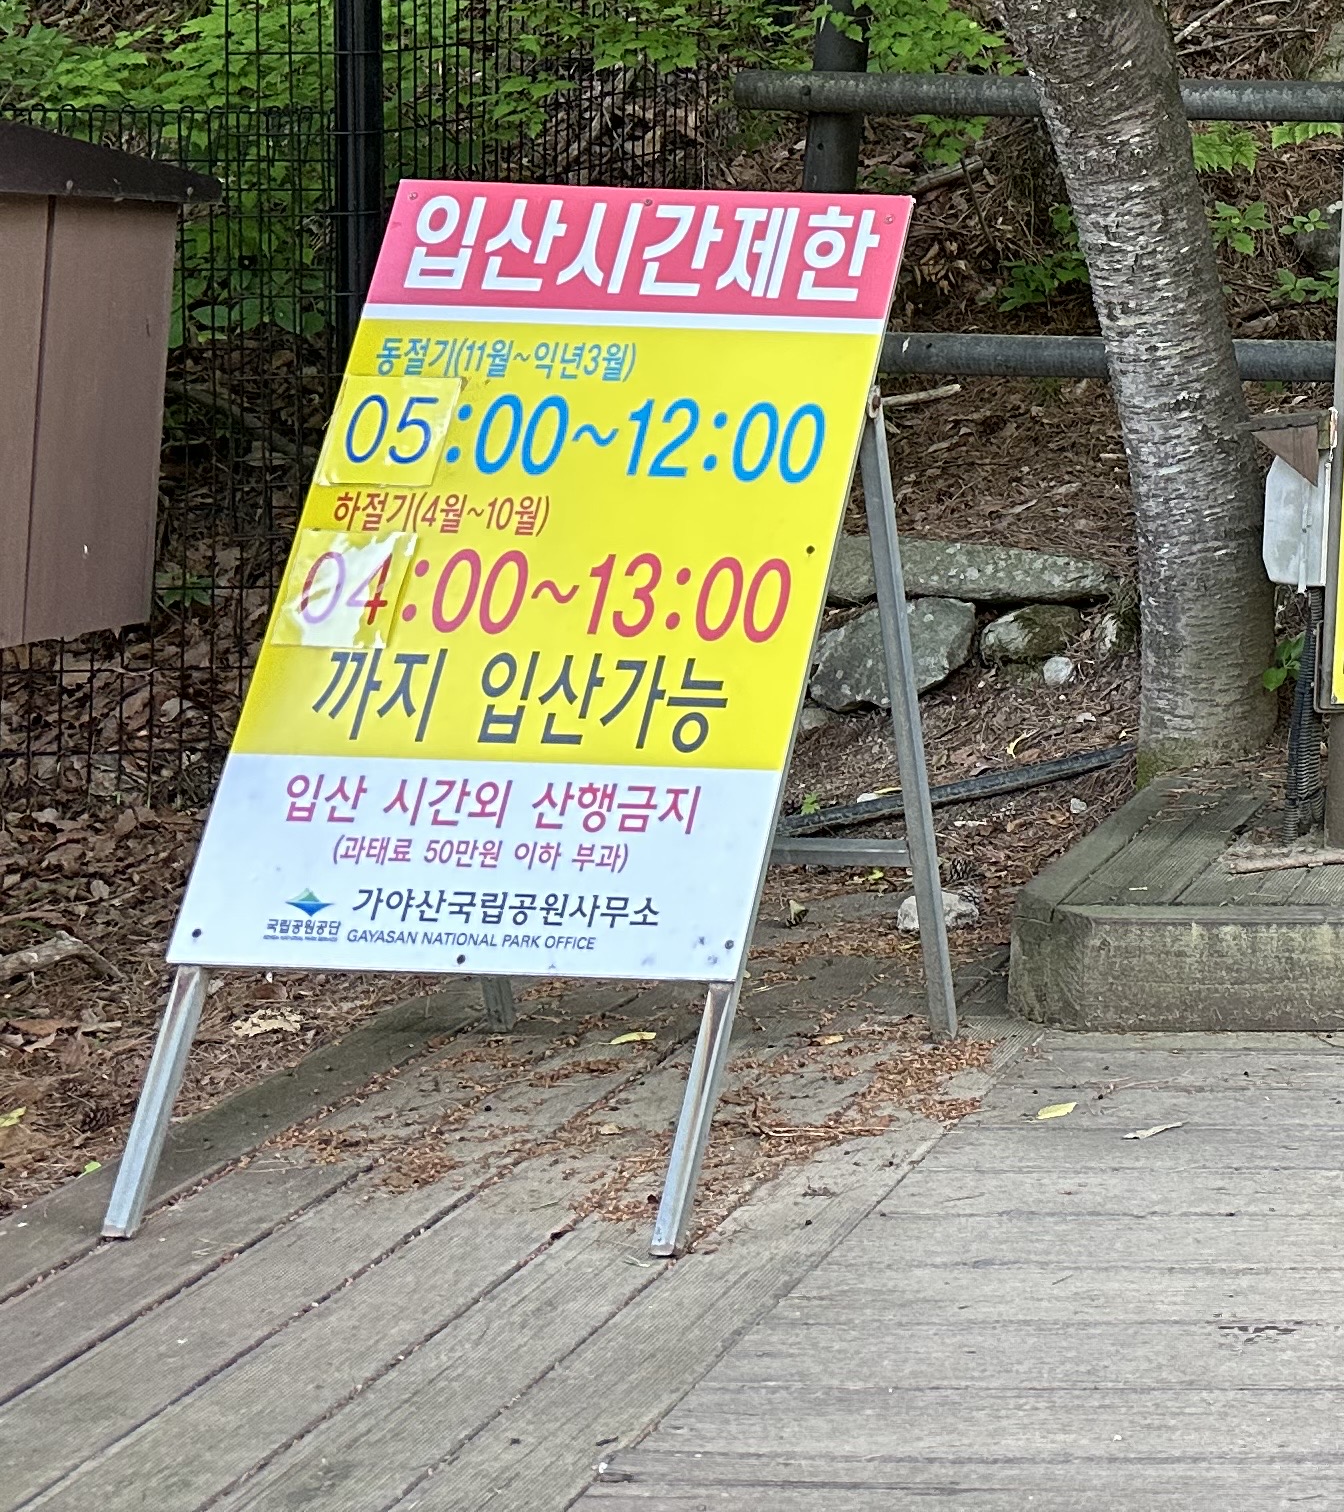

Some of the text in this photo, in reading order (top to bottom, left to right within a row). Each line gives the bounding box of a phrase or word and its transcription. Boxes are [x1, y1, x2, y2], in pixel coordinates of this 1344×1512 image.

[402, 195, 879, 301] 입산시간제한
[376, 337, 637, 383] 동절기(11월~익년3월)
[345, 393, 826, 484] 05:00~12:00
[334, 491, 550, 537] 하절기(4월~10월)
[301, 549, 792, 643] 04:00~13:00
[311, 648, 728, 754] 까지 입산가능
[285, 774, 702, 835] 입산 시간외 산행금지
[333, 834, 628, 874] (과태료 50만원 이하 부과)
[266, 918, 342, 936] 국립공원공단
[352, 887, 660, 929] 가야산국립공원사무소
[347, 929, 418, 947] GAYASAN
[421, 931, 498, 948] NATIONAL
[501, 934, 541, 949] PARK
[544, 935, 596, 950] OFFICE
